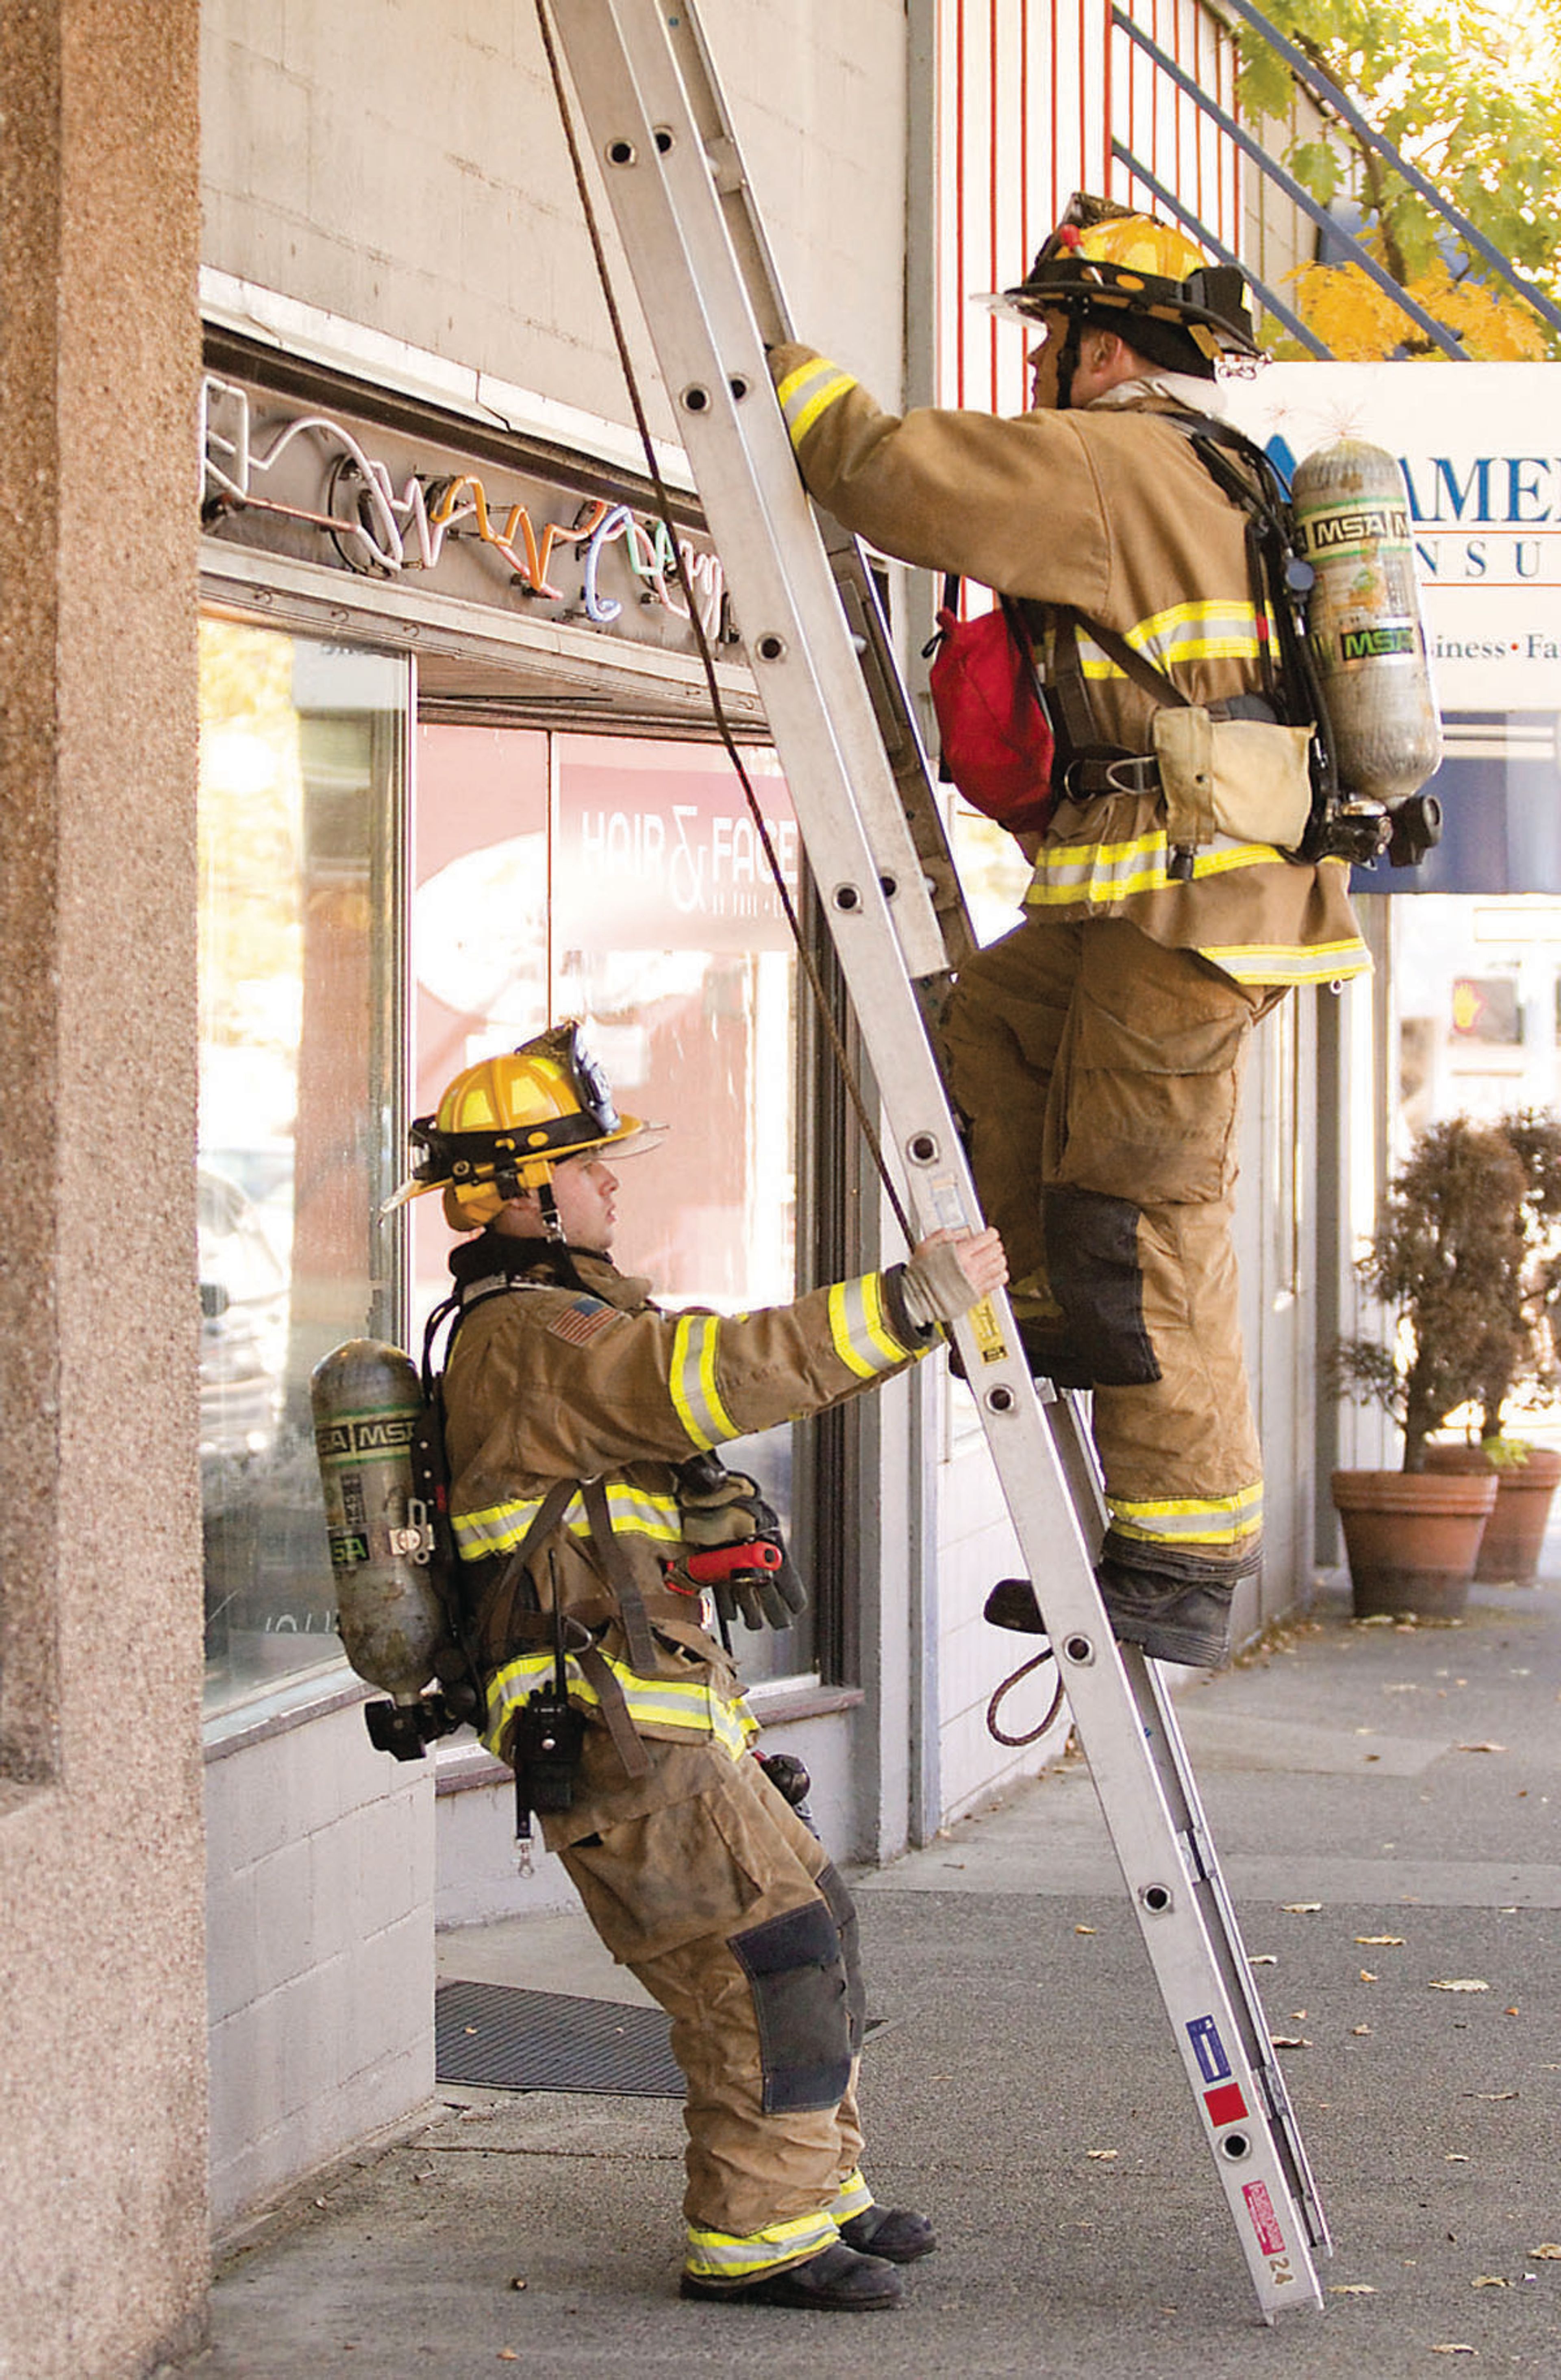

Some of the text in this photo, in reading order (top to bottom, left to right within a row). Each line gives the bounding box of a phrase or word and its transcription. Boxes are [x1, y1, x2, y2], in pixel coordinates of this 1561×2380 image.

[1398, 458, 1561, 521] AME
[1317, 513, 1387, 545] MSA
[1345, 630, 1413, 658] MSA
[582, 811, 666, 877] HAIR
[713, 817, 798, 884] FACE
[1269, 2257, 1294, 2284] 24
